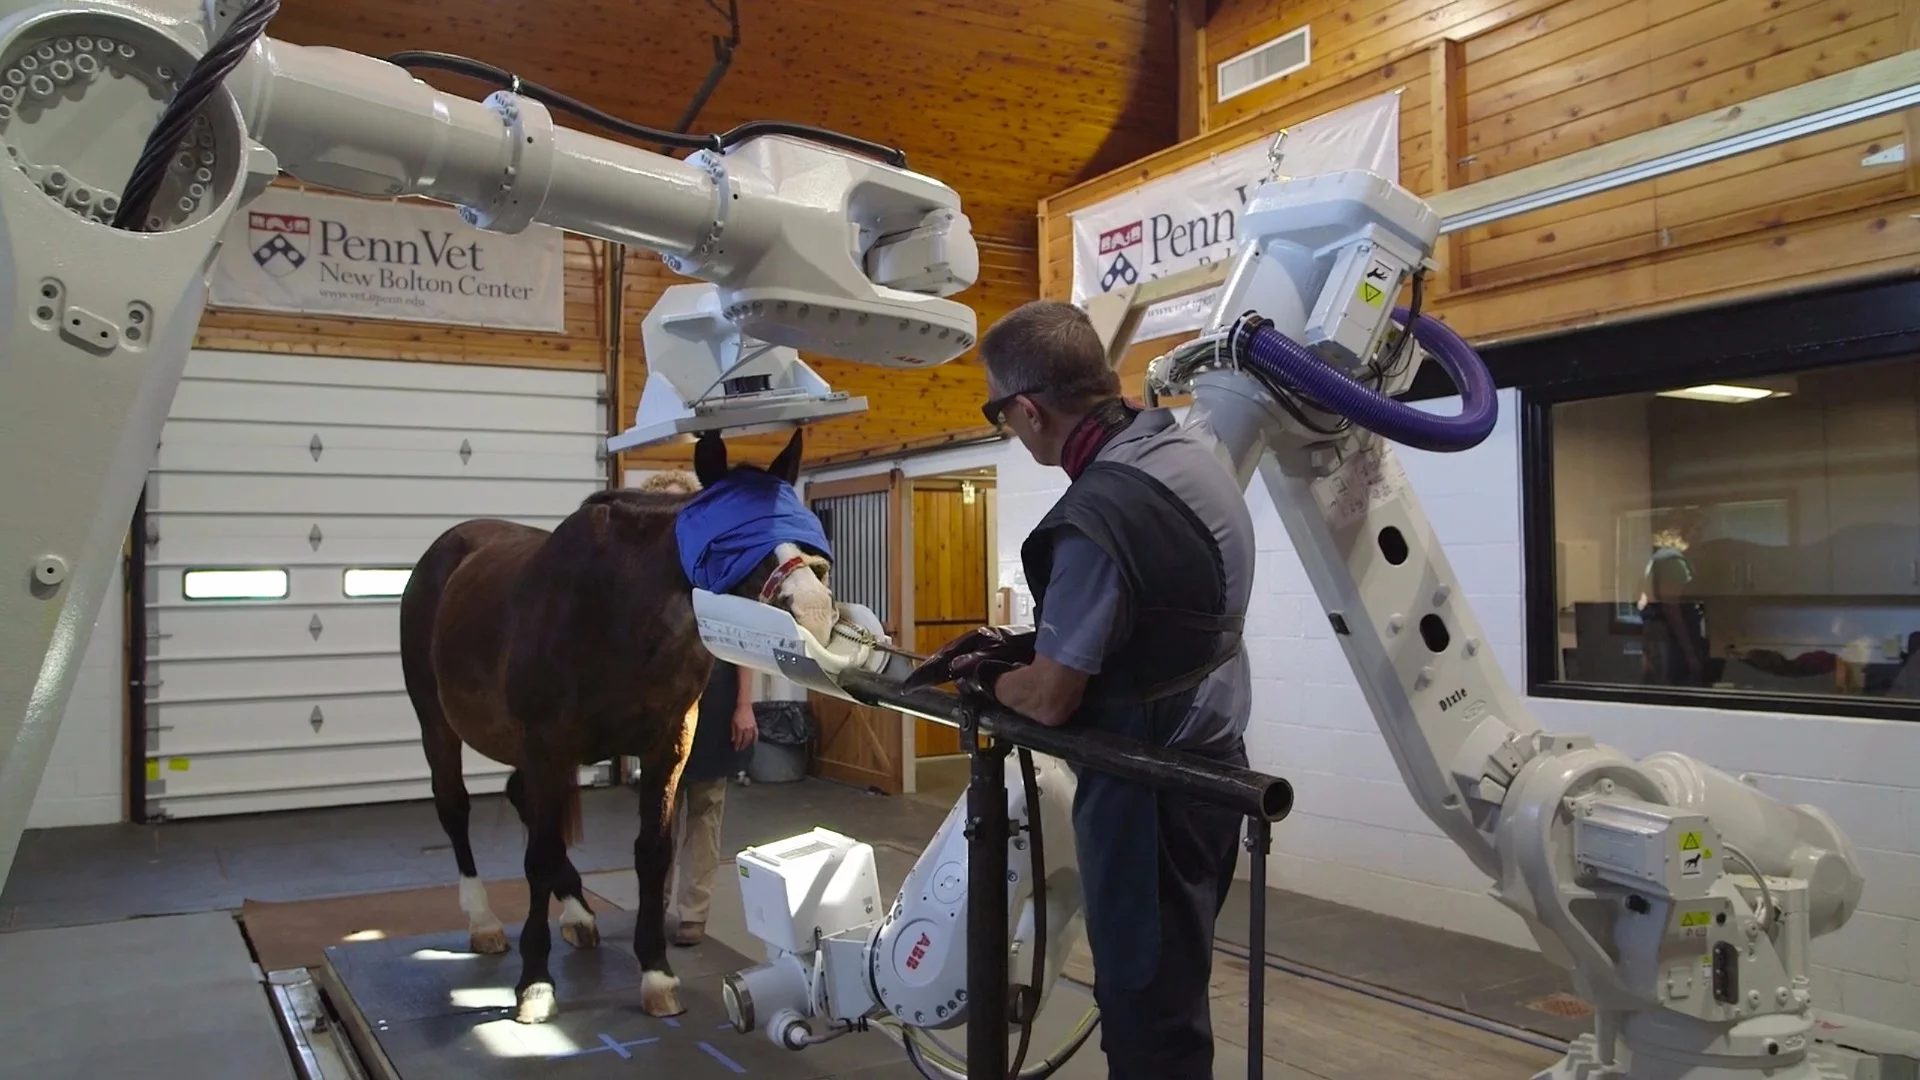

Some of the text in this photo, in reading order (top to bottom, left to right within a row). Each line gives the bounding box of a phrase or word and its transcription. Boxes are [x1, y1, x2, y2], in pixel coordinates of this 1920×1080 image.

[318, 220, 485, 272] PennVet
[320, 262, 534, 300] New Bolton Center
[906, 932, 930, 970] ABB
